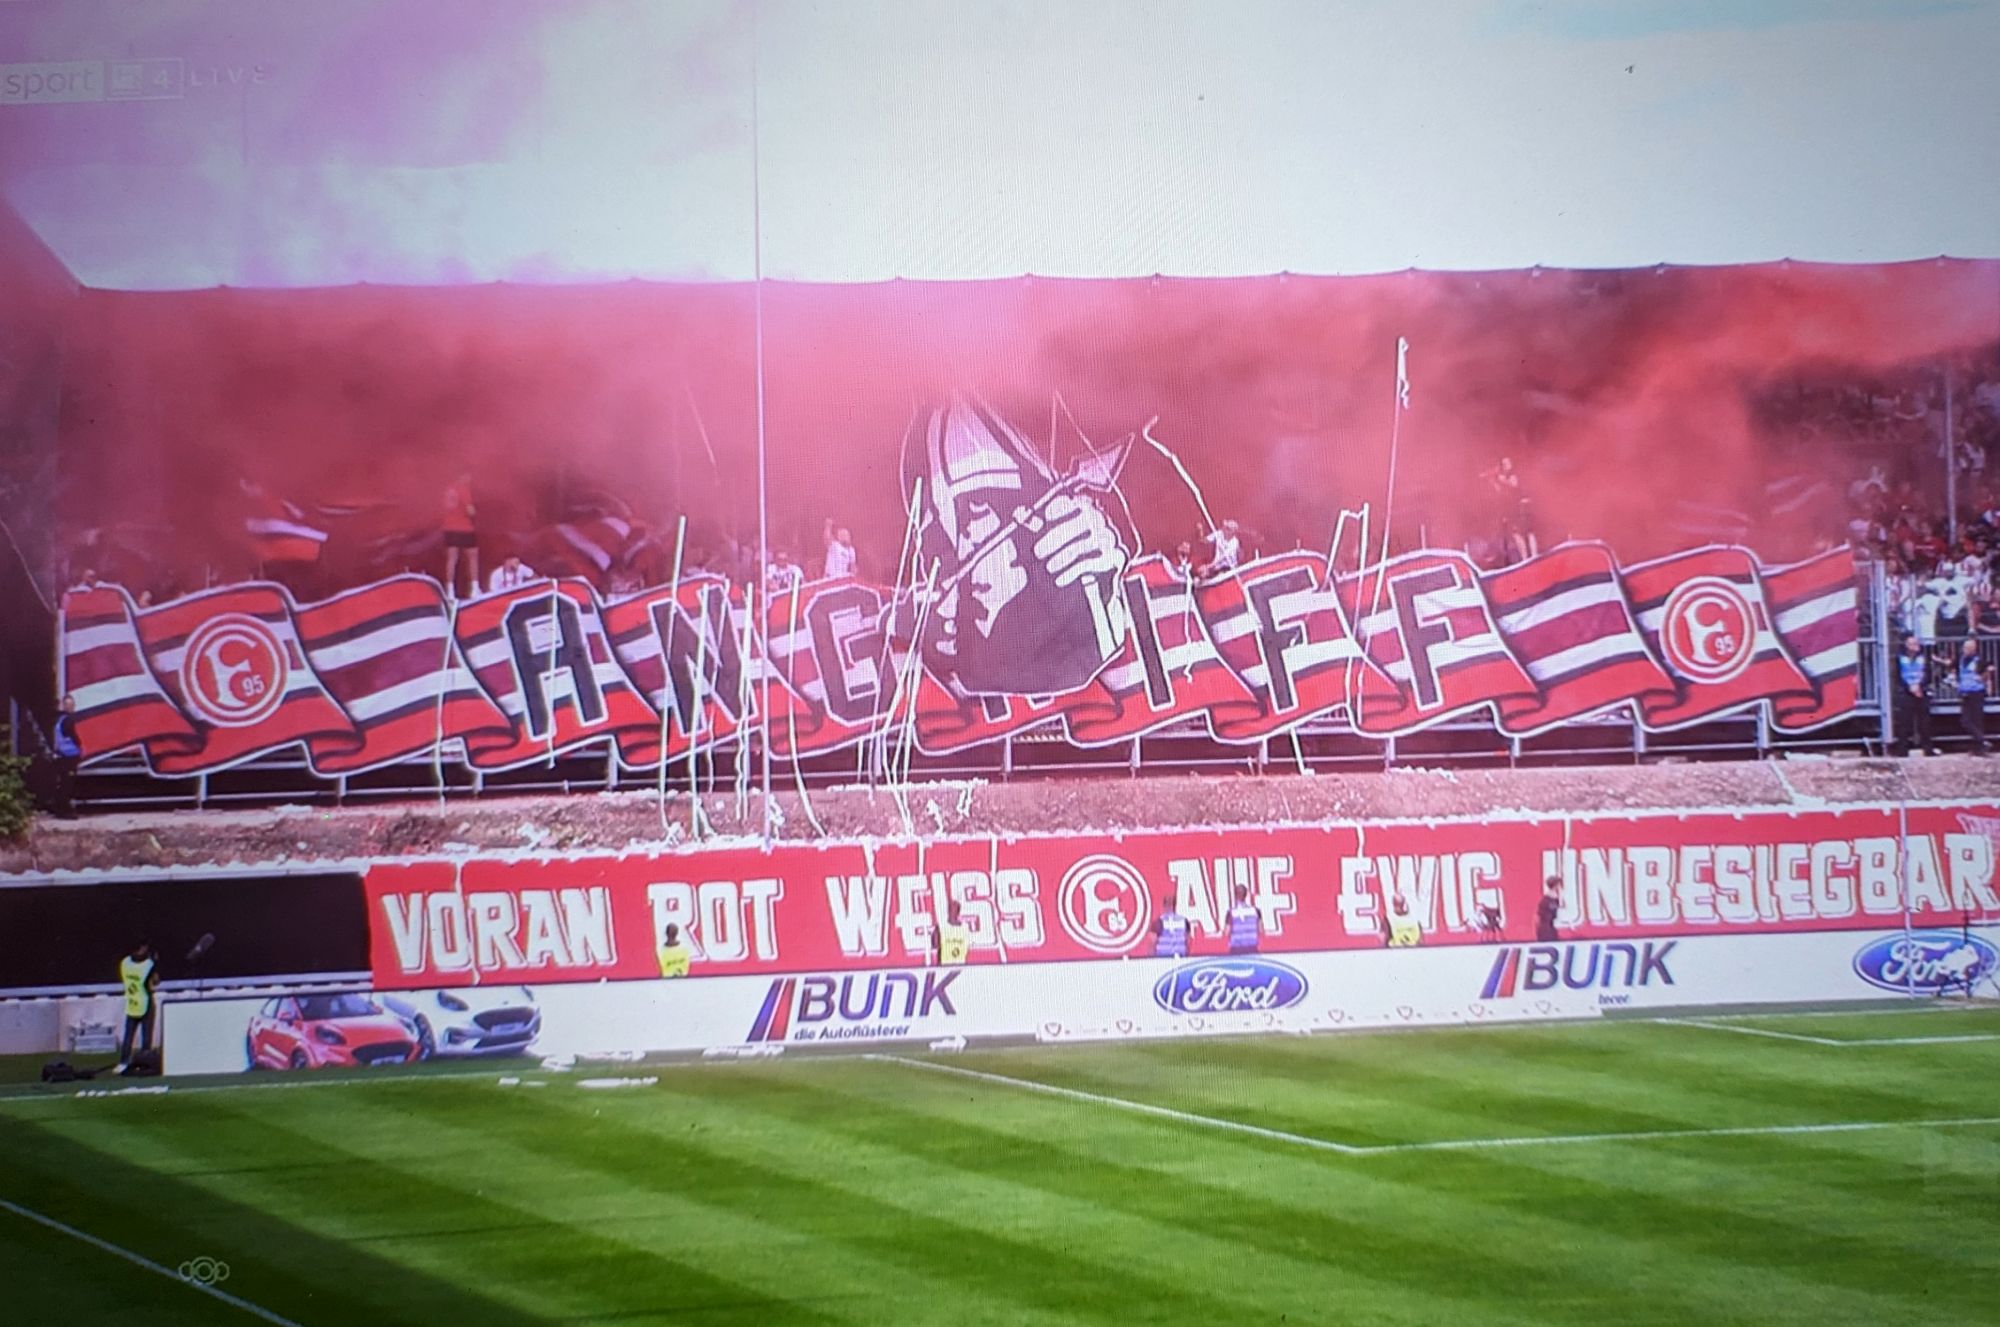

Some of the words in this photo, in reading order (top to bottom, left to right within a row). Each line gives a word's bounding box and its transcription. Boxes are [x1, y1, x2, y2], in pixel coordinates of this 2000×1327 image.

[501, 560, 1461, 743] ANGIFF
[381, 886, 617, 974] VORAN
[648, 877, 784, 963] ROT
[825, 868, 1046, 957] WEISS
[1337, 851, 1506, 935] EWIG
[1542, 832, 2000, 926] UNBESIEGBAR
[1182, 967, 1280, 1012] Ford
[1523, 941, 1678, 991] BUNK
[798, 970, 962, 1022] BUNK
[819, 1023, 911, 1040] Autoflüsterer
